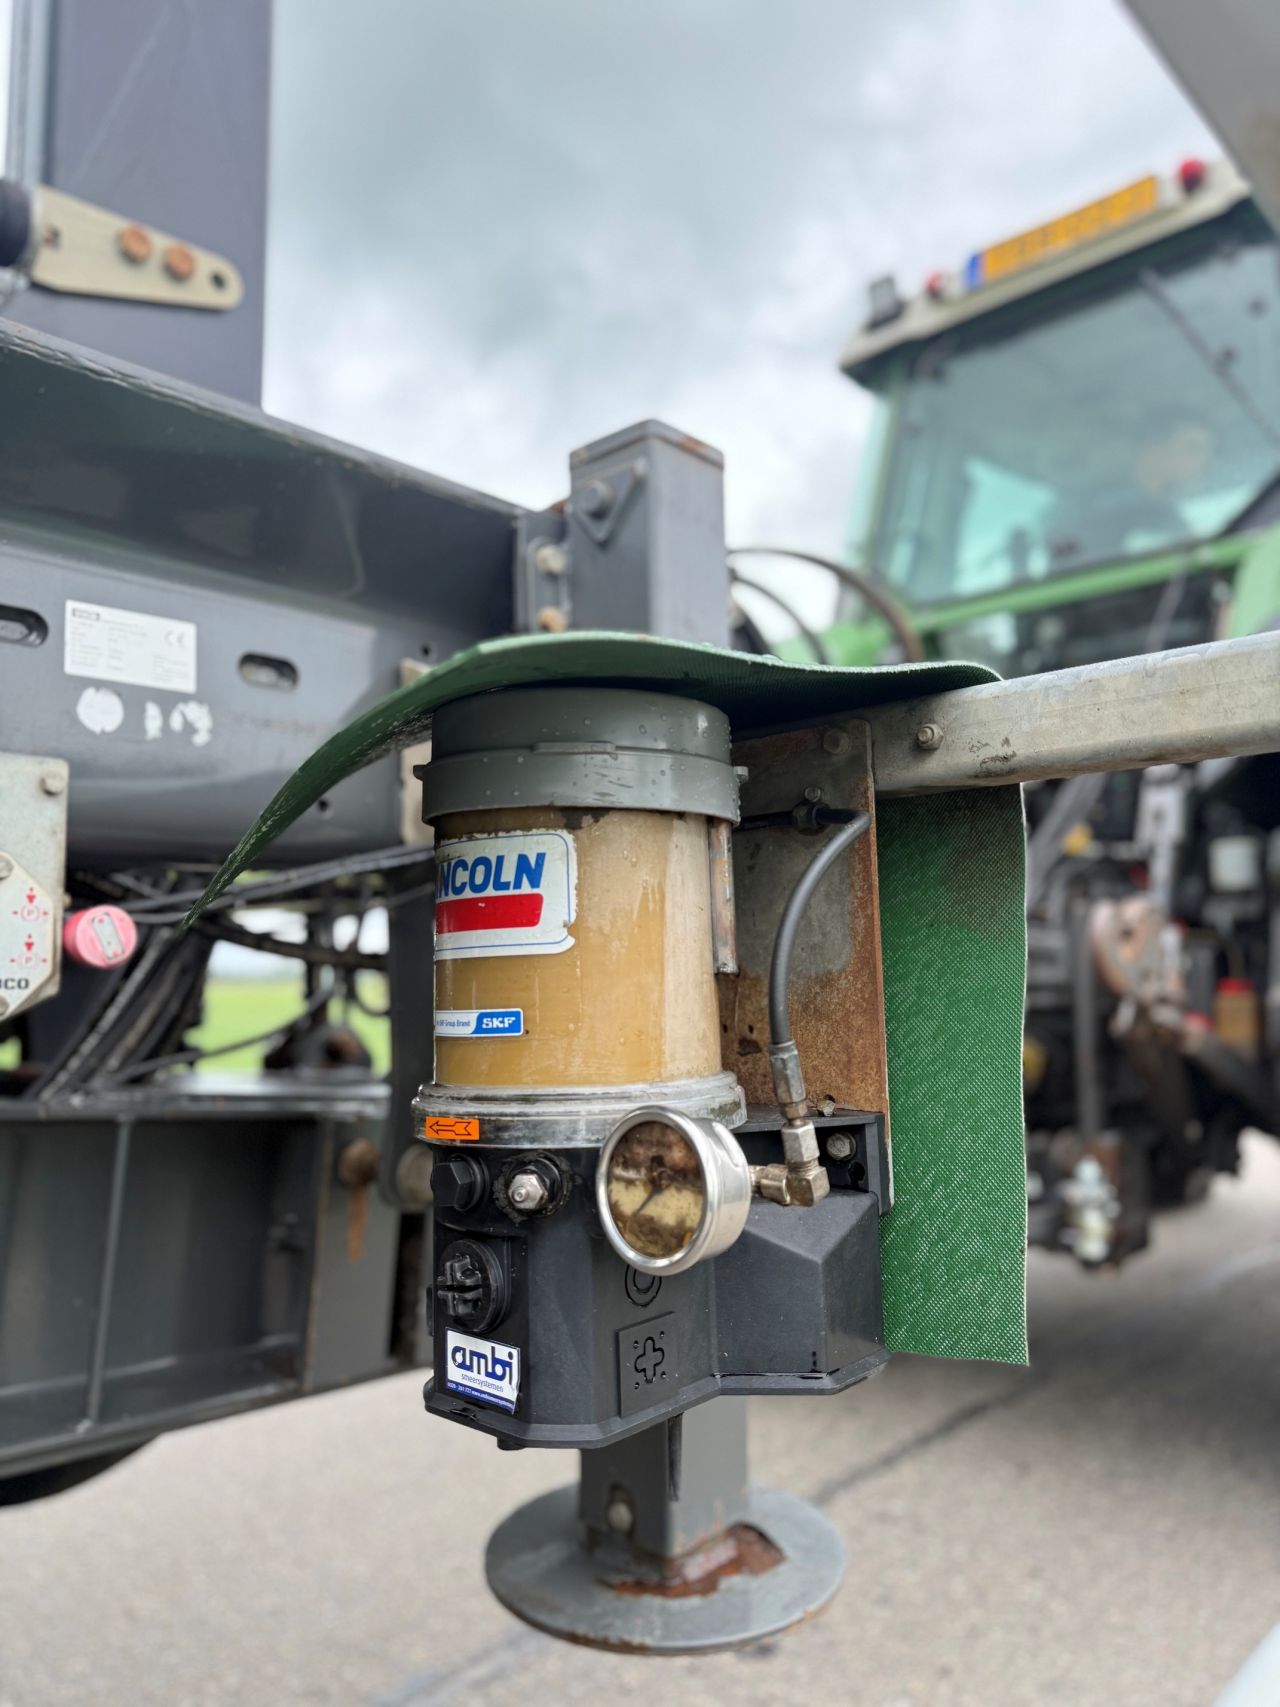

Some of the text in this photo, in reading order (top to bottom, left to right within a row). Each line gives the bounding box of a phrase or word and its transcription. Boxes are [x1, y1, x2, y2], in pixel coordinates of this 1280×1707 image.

[0, 977, 29, 990] CO
[482, 1016, 516, 1029] SKF
[451, 1345, 514, 1386] ambi
[461, 1373, 504, 1393] smeersystemen
